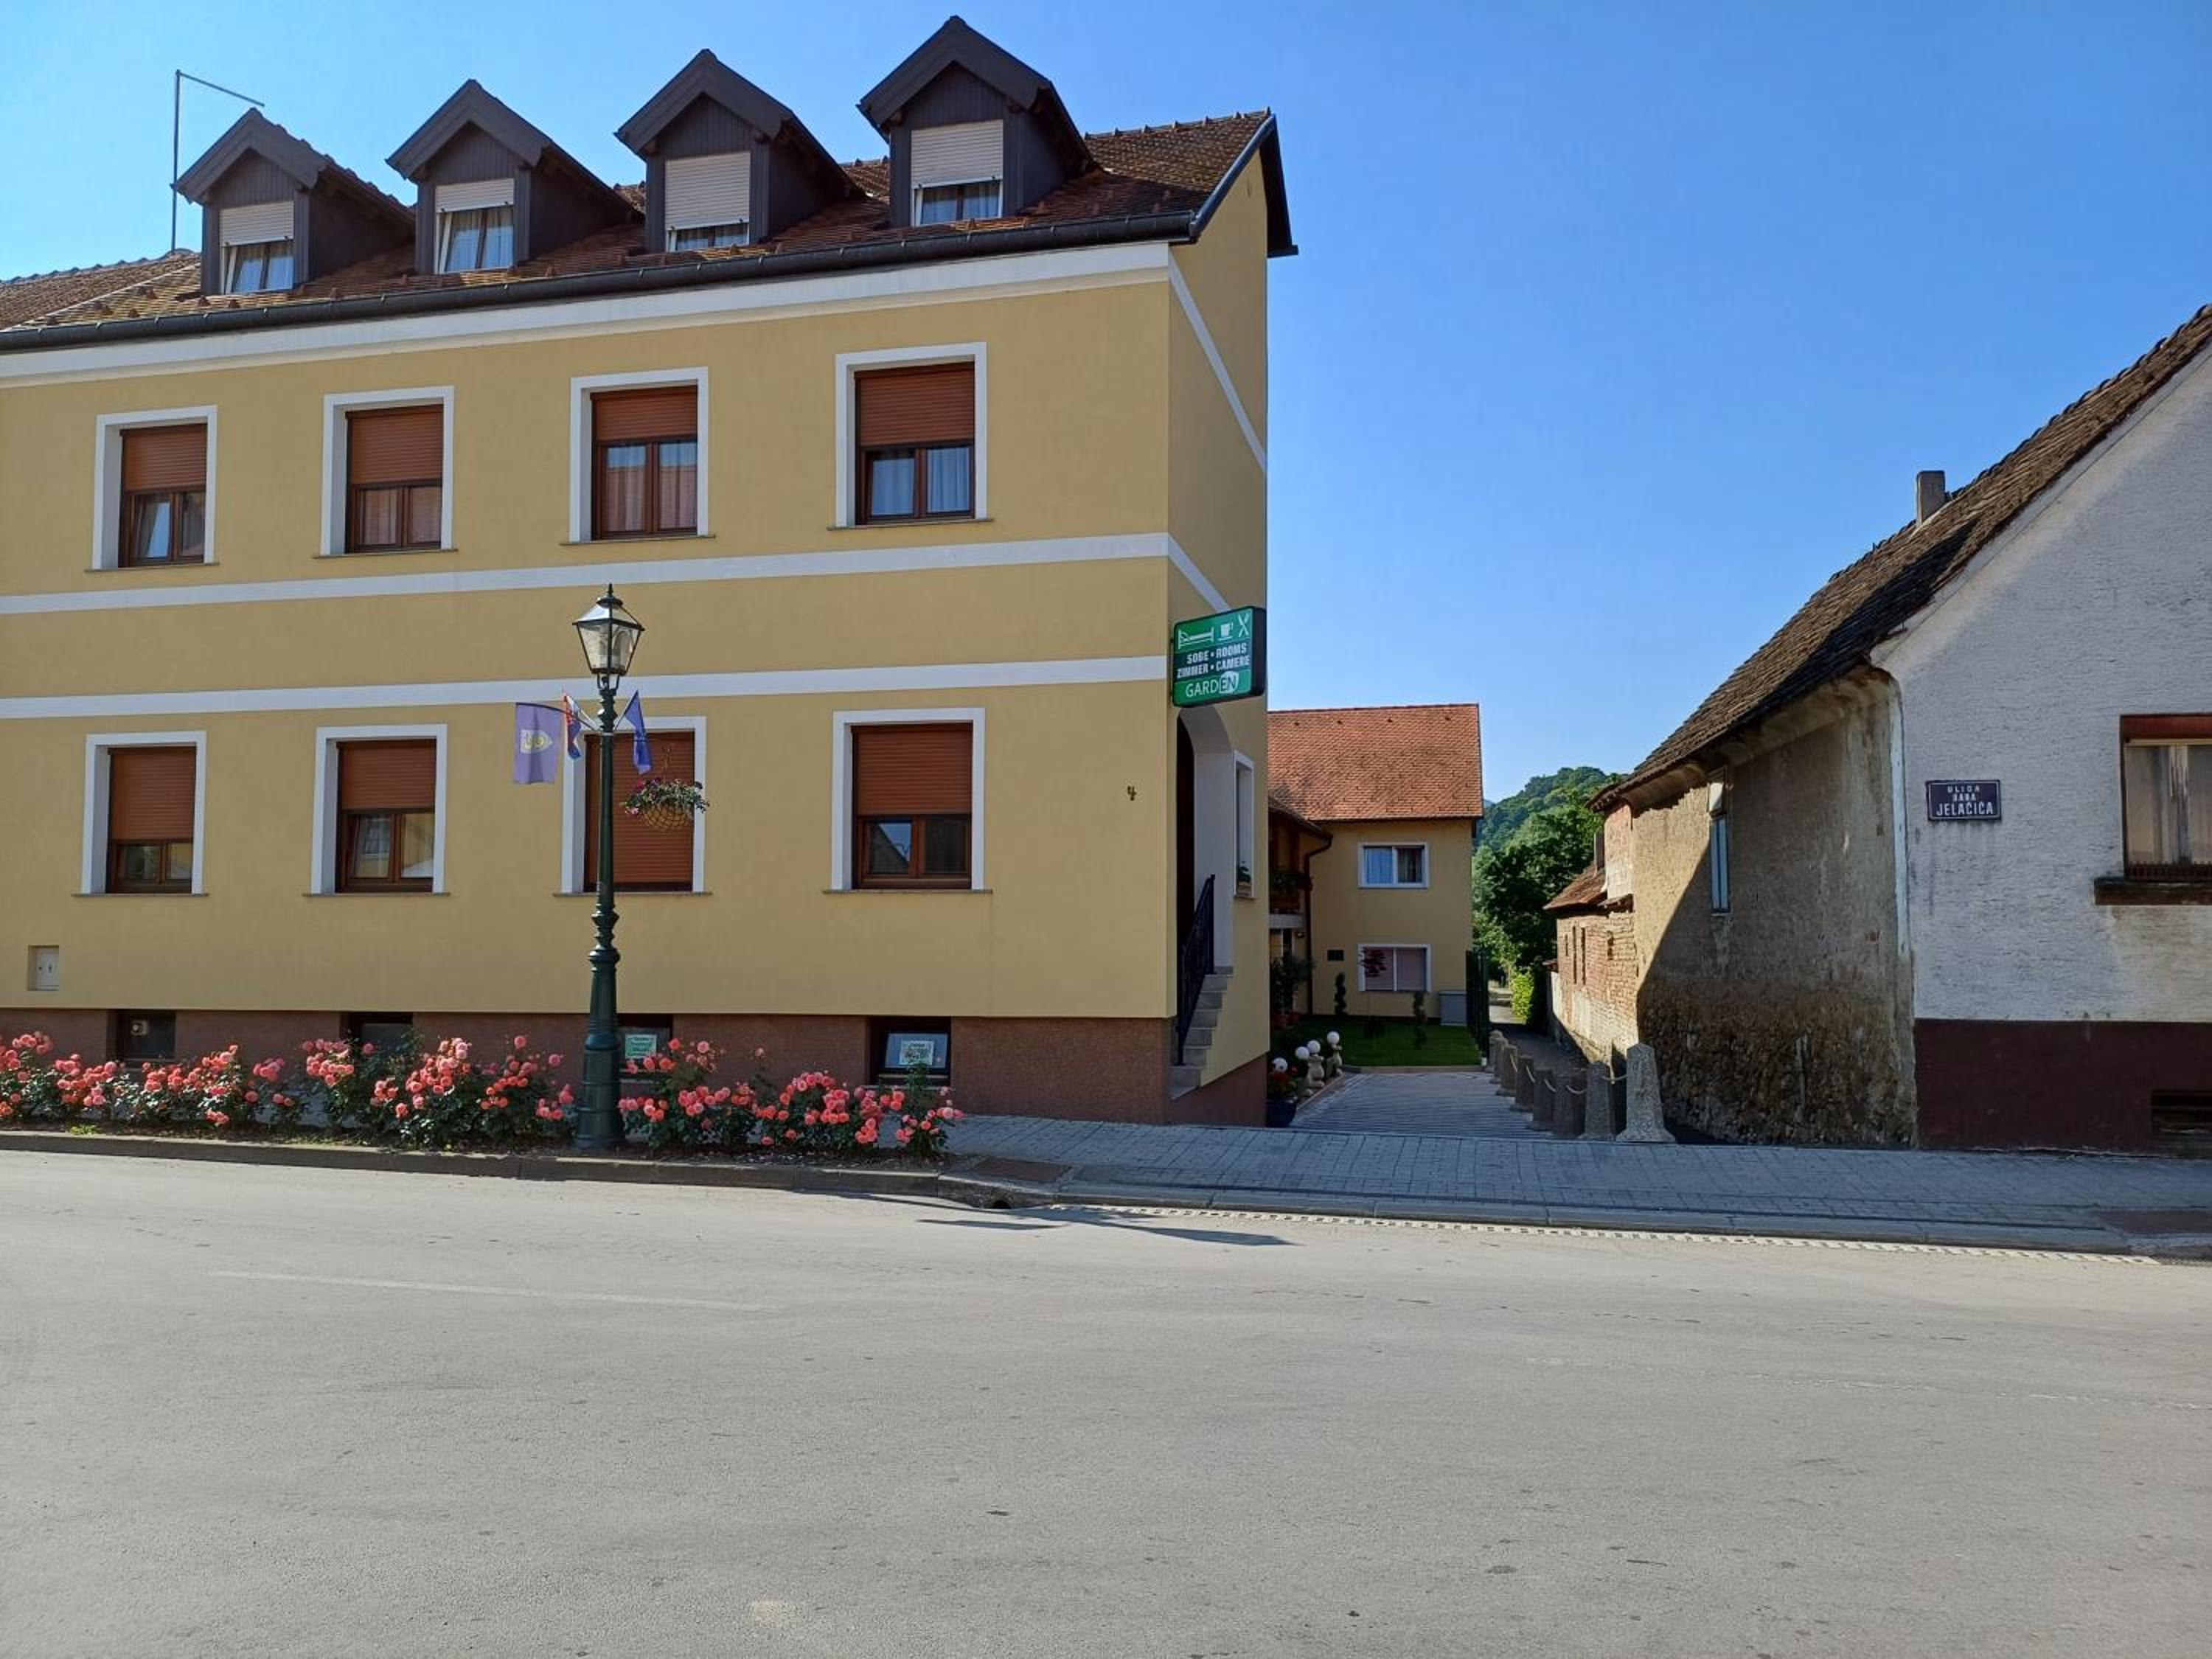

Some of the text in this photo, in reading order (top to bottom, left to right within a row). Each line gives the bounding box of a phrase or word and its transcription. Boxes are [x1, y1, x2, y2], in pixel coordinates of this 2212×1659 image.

[1186, 642, 1247, 664] SOBE ROOMS
[1177, 664, 1208, 678] ZIMMER
[1185, 673, 1238, 698] GARDEN
[1127, 785, 1137, 801] 4
